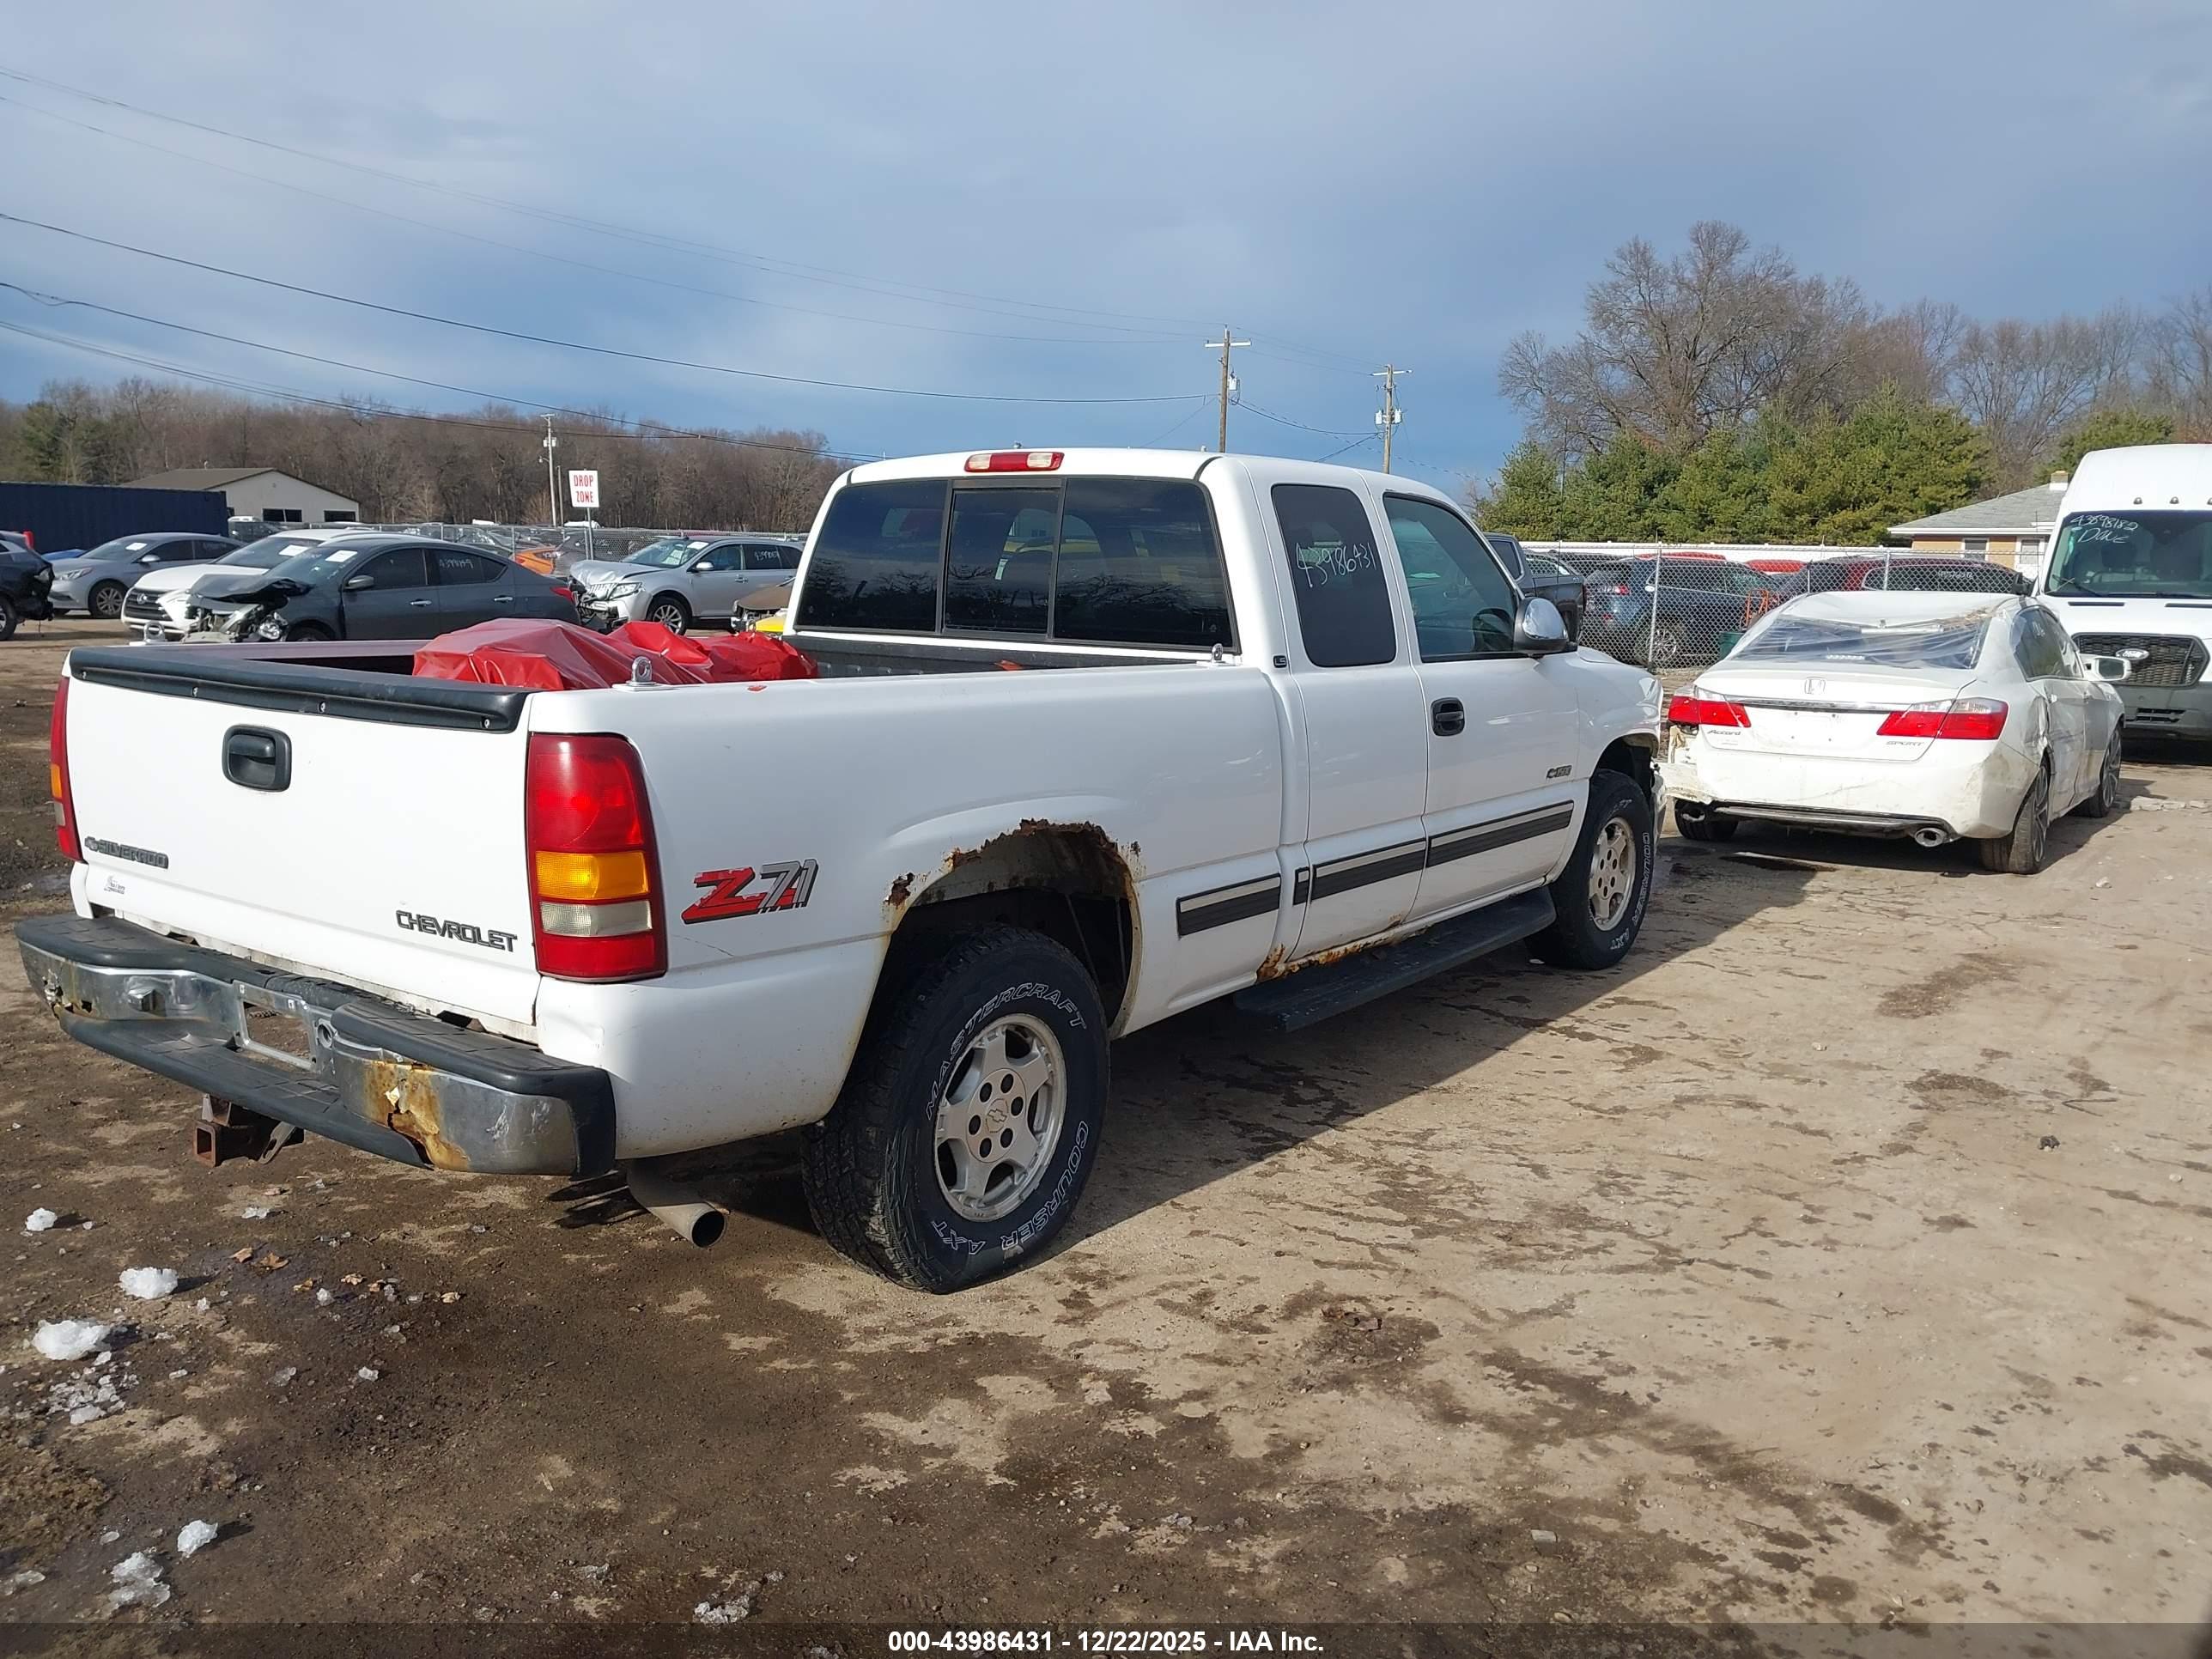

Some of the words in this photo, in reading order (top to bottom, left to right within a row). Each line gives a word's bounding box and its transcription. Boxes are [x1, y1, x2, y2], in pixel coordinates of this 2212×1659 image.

[574, 475, 593, 487] DROP
[575, 490, 594, 502] ZONE
[1296, 542, 1377, 588] 43986431
[98, 839, 169, 869] SILVERADO
[681, 859, 818, 925] Z71
[396, 910, 518, 952] CHEVROLET
[926, 982, 1087, 1121] MASTERCRAFT
[1000, 1121, 1089, 1250] COURSER
[931, 1219, 987, 1255] AXT
